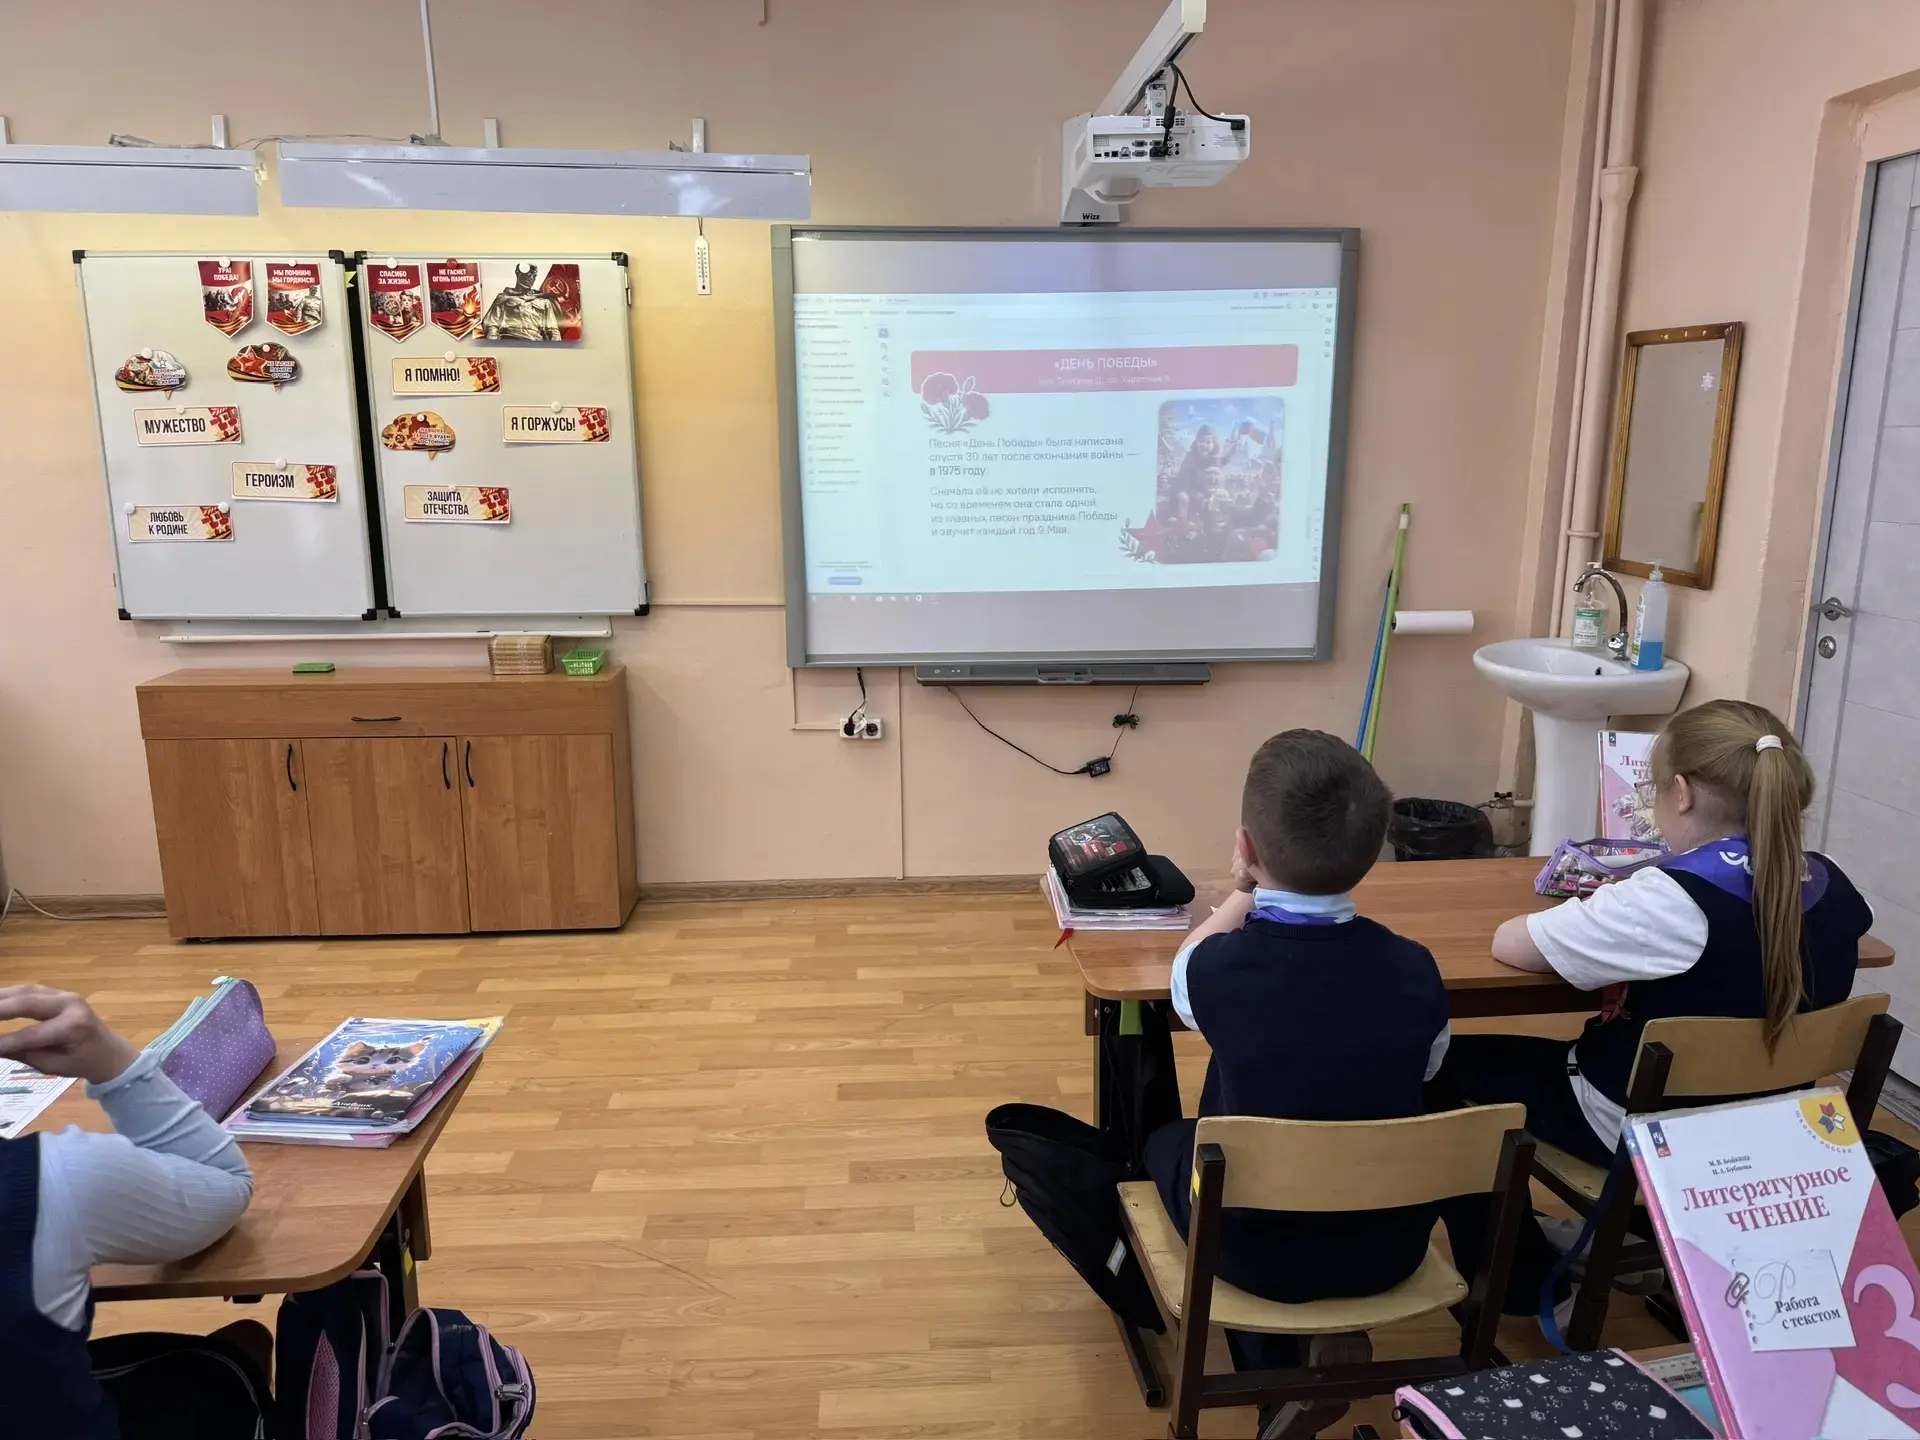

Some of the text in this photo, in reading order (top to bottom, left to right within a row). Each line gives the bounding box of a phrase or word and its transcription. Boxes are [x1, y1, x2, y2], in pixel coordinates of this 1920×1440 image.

[379, 270, 407, 278] СПАСИБО
[1054, 357, 1158, 371] «ДЕНЬ ПОБЕДЫ»
[404, 368, 460, 382] Я ПОМНЮ!
[145, 418, 206, 434] МУЖЕСТВО
[511, 416, 576, 432] Я ГОРЖУСЬ!
[929, 437, 1124, 450] Песня «День Победы» была написана
[929, 453, 963, 463] спустя
[966, 452, 979, 461] 30
[981, 453, 998, 461] лет
[1001, 453, 1031, 461] после
[1033, 451, 1089, 461] окончания
[1090, 449, 1124, 459] войны
[930, 466, 989, 477] в 1975 году.
[245, 473, 295, 488] ГЕРОИЗМ
[427, 491, 462, 502] ЗАЩИТА
[930, 485, 1097, 496] Сначала её не хотели исполнять,
[423, 503, 469, 515] ОТЕЧЕСТВА
[931, 498, 1097, 510] но со временем она стала одной
[150, 511, 184, 523] ЛЮБОВЬ
[931, 511, 1118, 523] из главных песен праздника Победы
[149, 524, 188, 536] К РОДИНЕ
[931, 525, 1069, 537] и звучит каждый год 9 Мая.
[1795, 1110, 1853, 1154] ШКОЛА РОССИИ
[1681, 1164, 1852, 1212] Литературное
[1725, 1194, 1831, 1232] ЧТЕНИЕ
[1774, 1295, 1821, 1314] Работа
[1781, 1308, 1842, 1330] с текстом
[1853, 1263, 1920, 1409] 3
